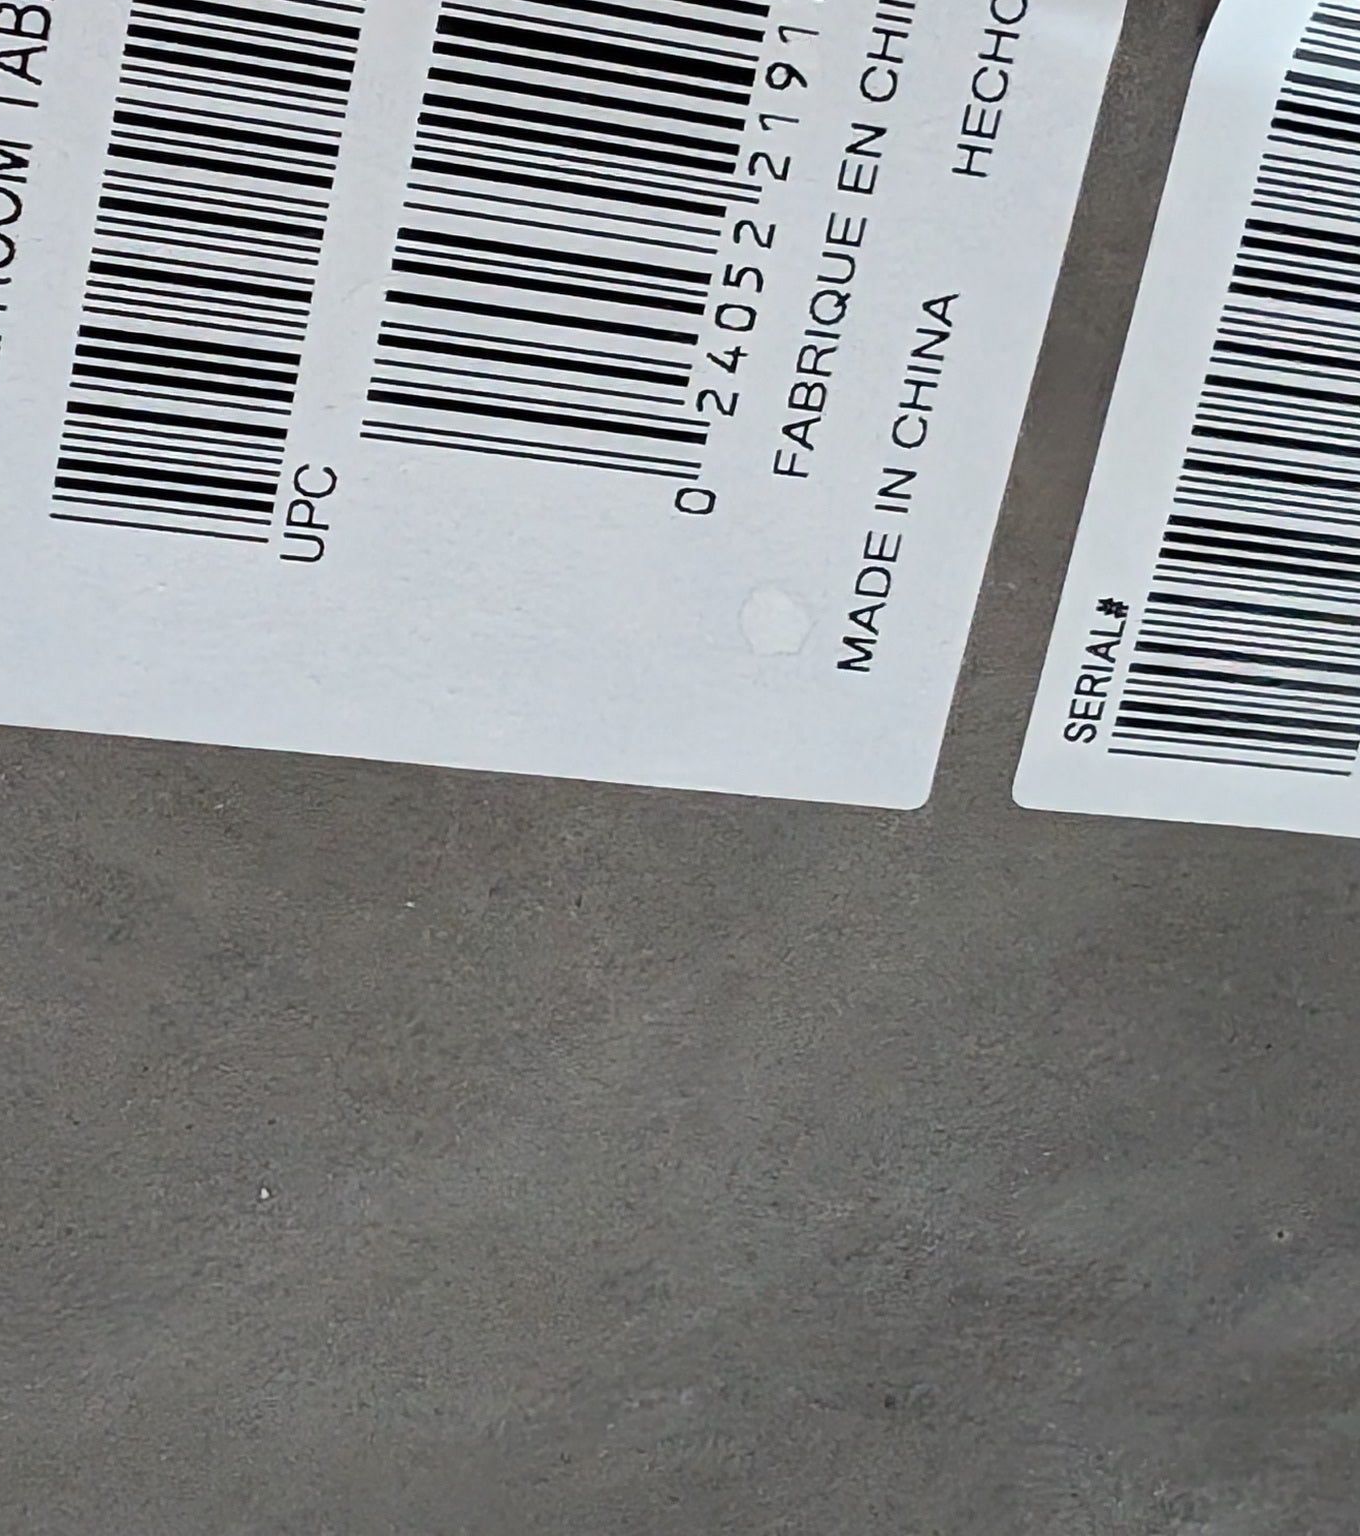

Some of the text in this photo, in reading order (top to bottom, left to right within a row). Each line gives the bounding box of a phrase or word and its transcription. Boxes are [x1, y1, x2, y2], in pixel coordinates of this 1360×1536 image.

[695, 217, 778, 419] 24052
[774, 213, 870, 479] FABRIQUE
[840, 123, 888, 195] EN
[278, 461, 338, 563] UPC
[675, 486, 717, 517] 0
[837, 292, 961, 674] MADE IN CHINA
[1063, 596, 1130, 745] SERIAL#
